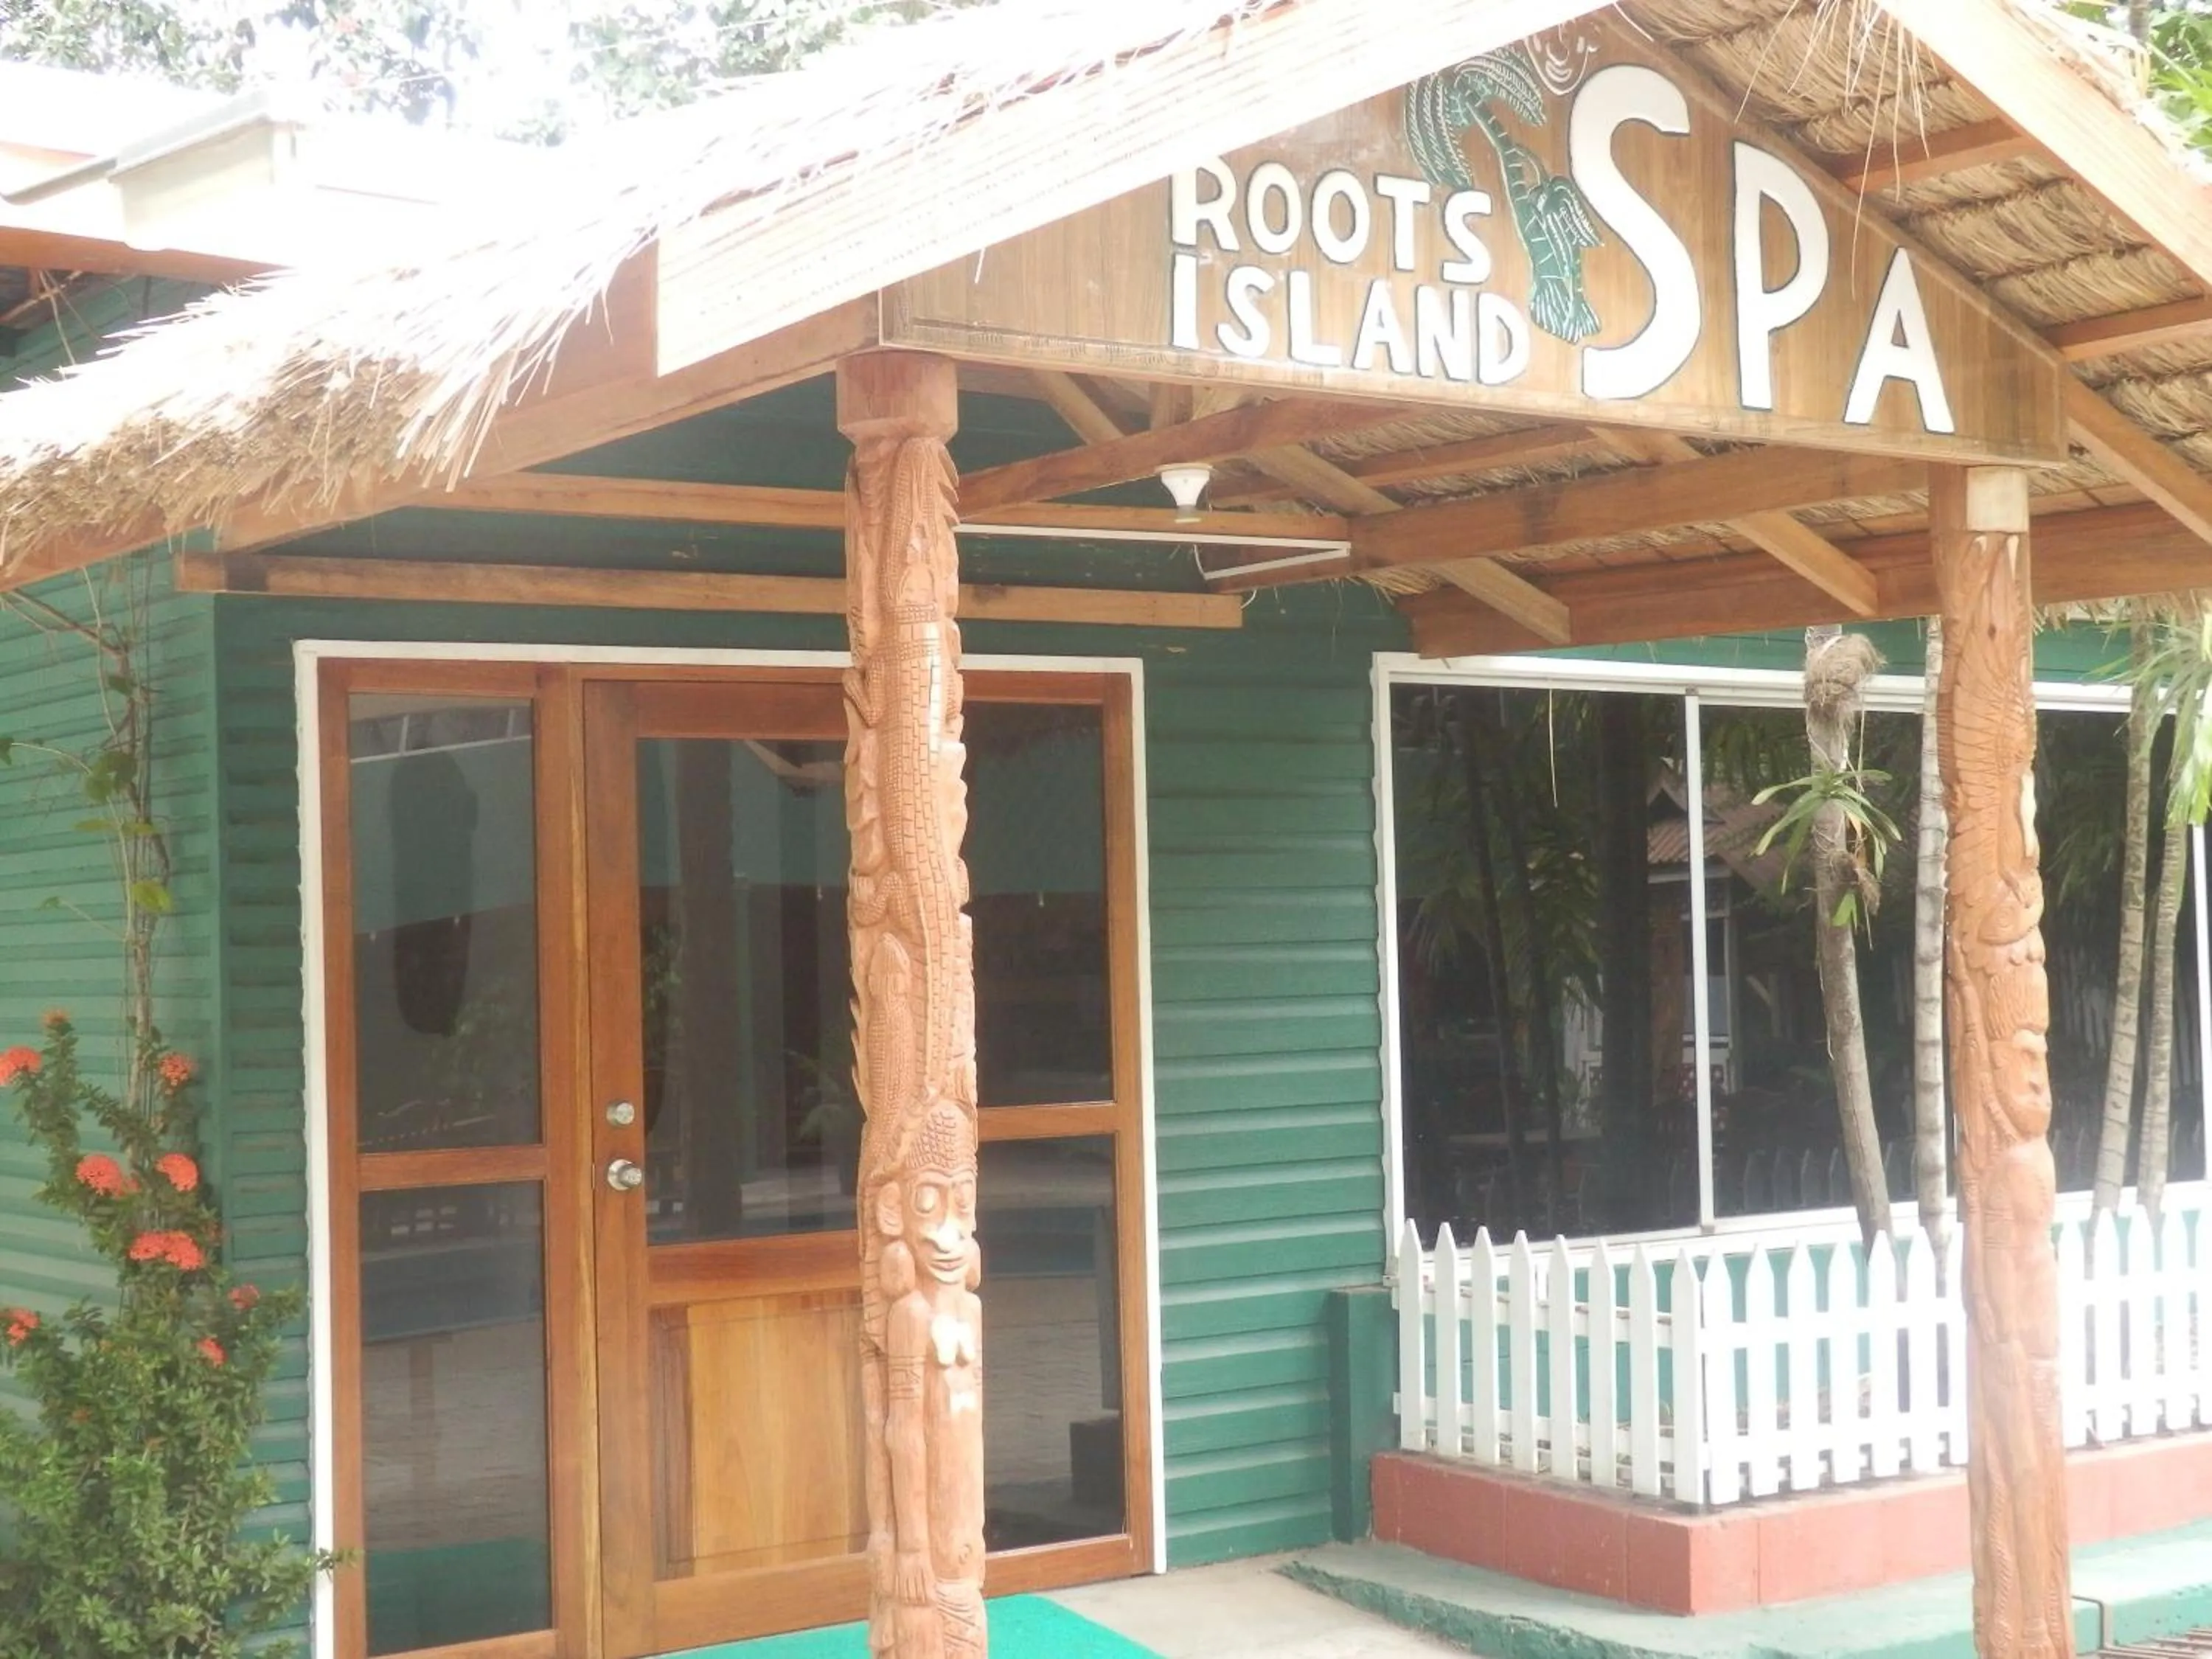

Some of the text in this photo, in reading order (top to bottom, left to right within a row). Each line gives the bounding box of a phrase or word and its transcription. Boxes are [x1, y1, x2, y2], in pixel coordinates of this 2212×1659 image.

[1172, 155, 1492, 285] ROOTS
[1568, 64, 1955, 434] SPA
[1171, 252, 1530, 385] ISLAND
